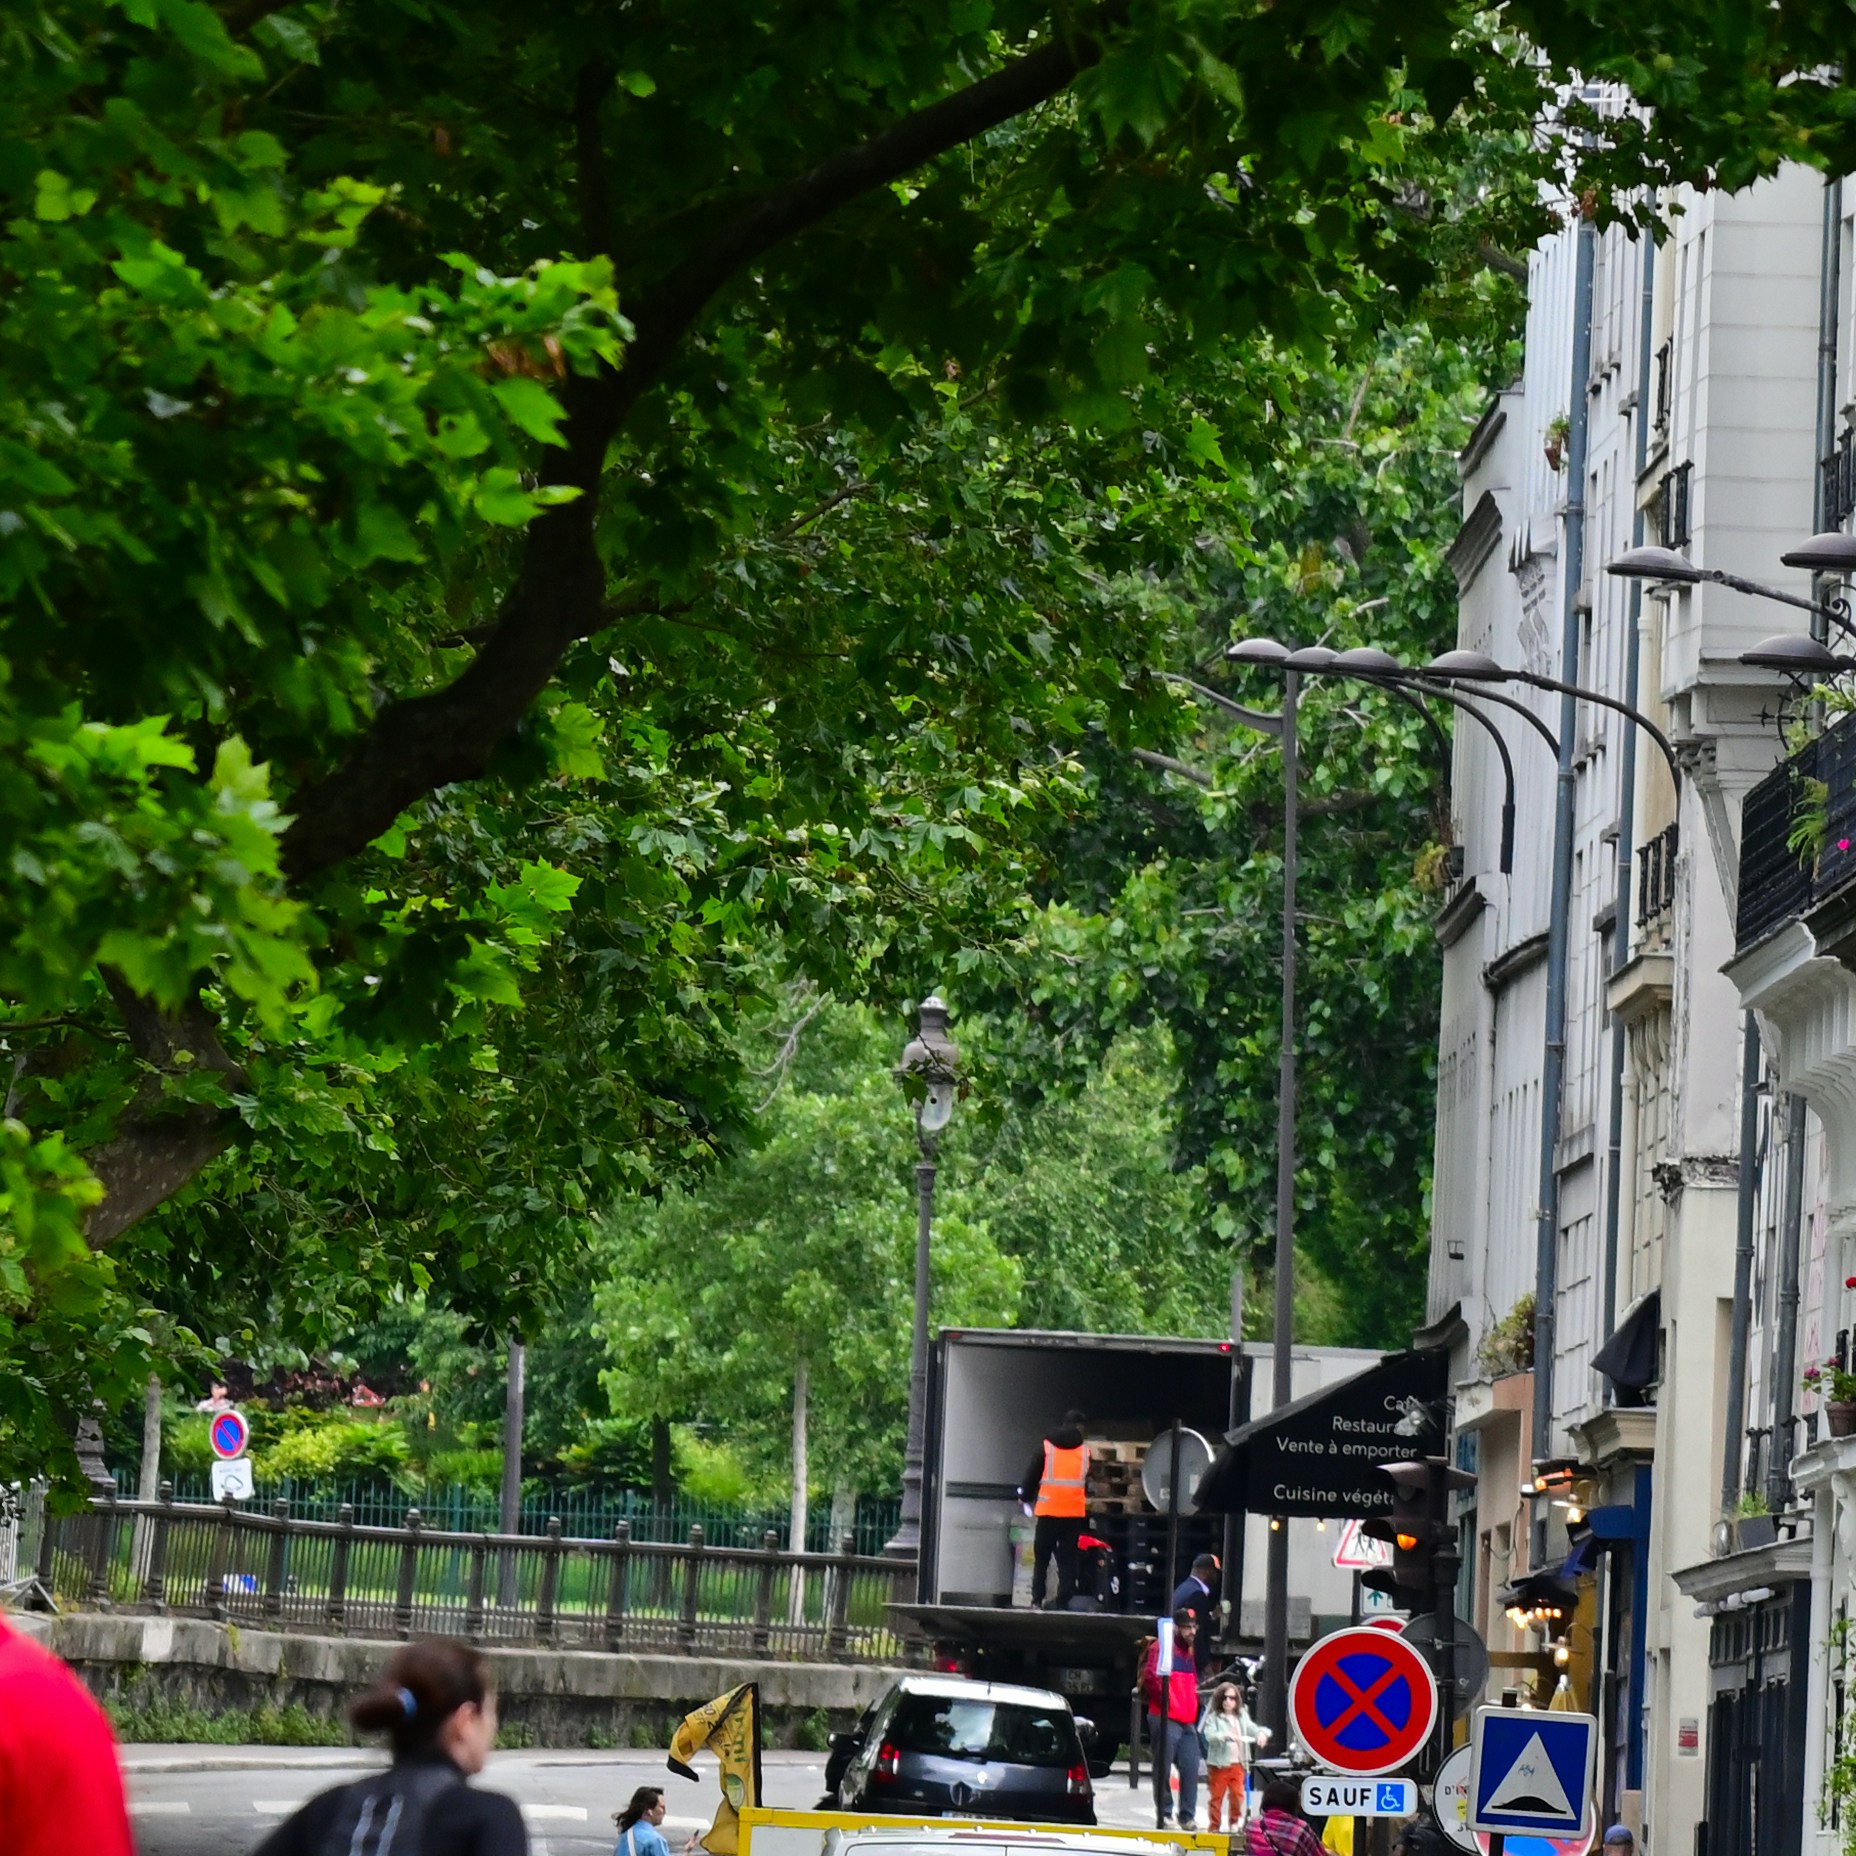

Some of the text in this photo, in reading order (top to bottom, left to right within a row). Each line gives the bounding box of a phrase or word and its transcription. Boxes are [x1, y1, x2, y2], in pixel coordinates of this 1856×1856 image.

[1332, 1416, 1395, 1434] Restaur
[1276, 1436, 1417, 1459] Vente à emporter
[1273, 1484, 1337, 1502] Cuisine
[1309, 1787, 1371, 1806] SAUF
